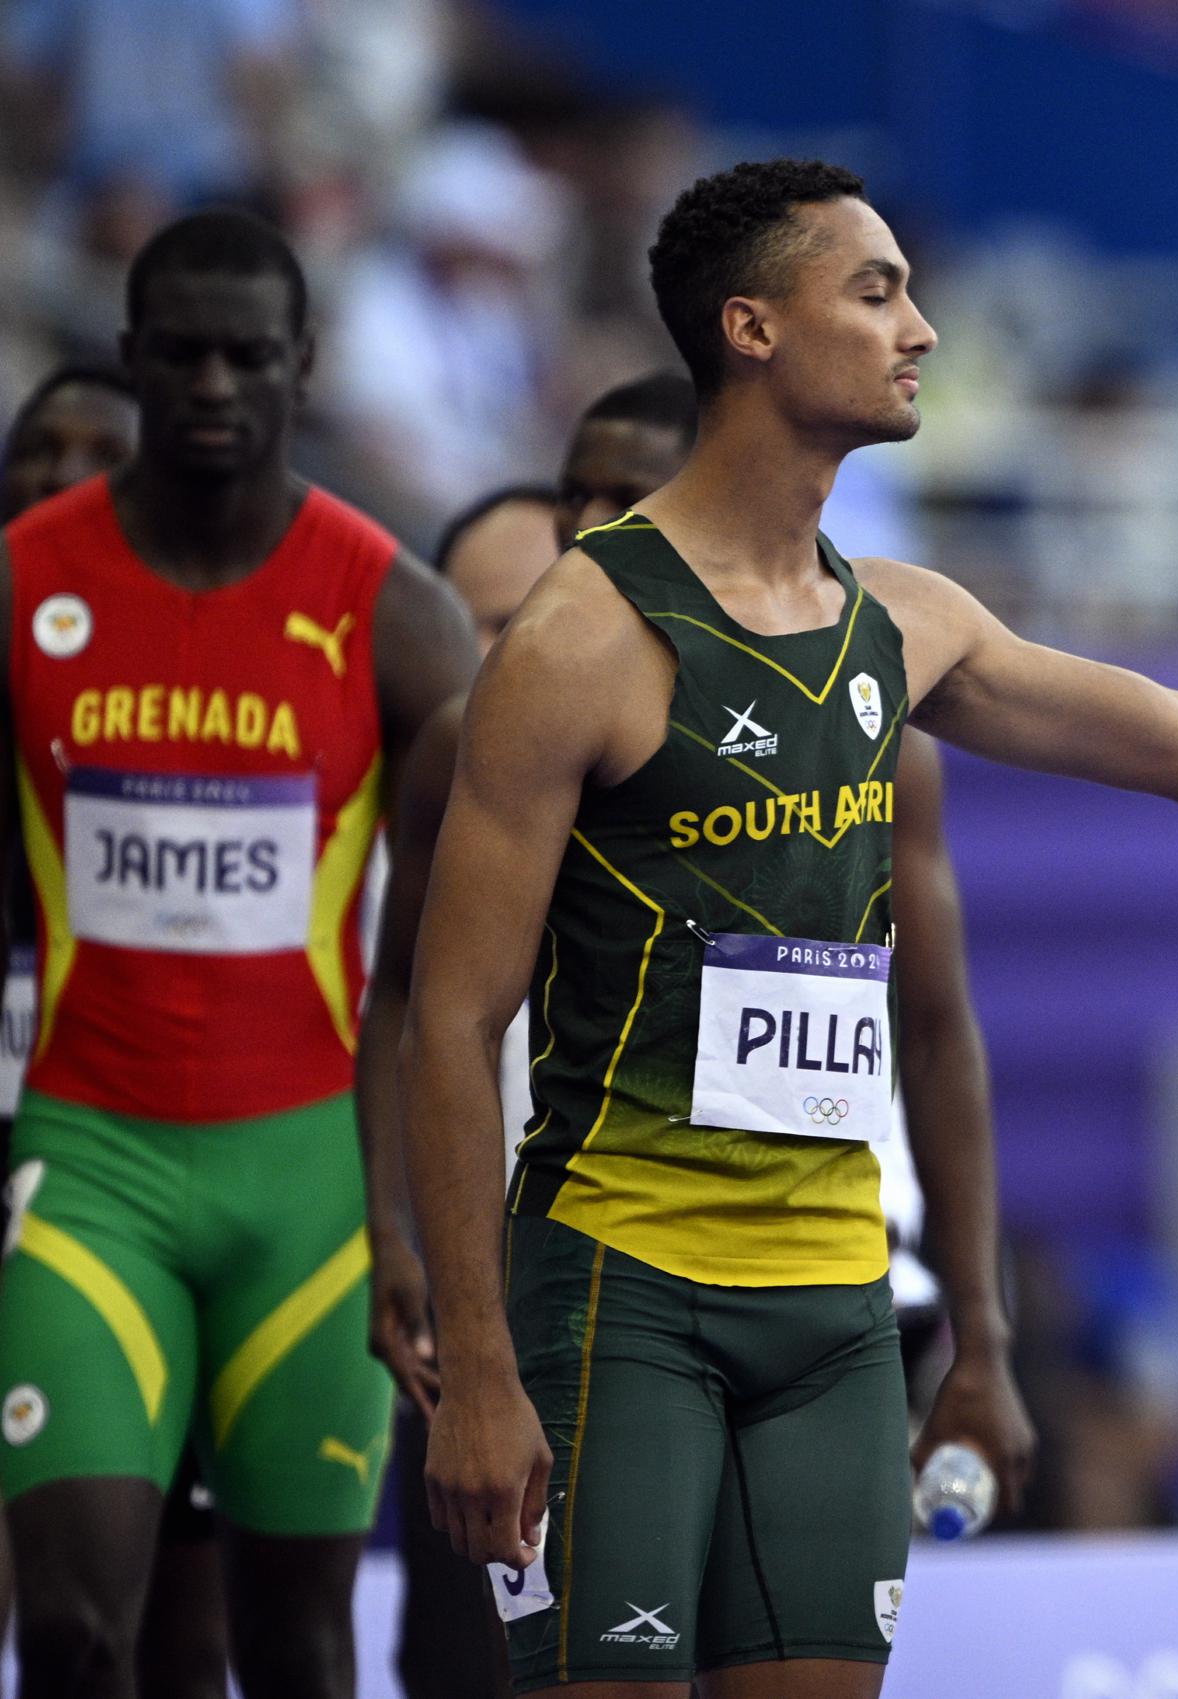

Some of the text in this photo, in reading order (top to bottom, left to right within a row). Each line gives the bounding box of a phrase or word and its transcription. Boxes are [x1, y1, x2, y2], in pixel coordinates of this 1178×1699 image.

[72, 685, 299, 759] GRENADA
[669, 780, 893, 849] SOUTH AFRI
[95, 829, 279, 897] JAMES
